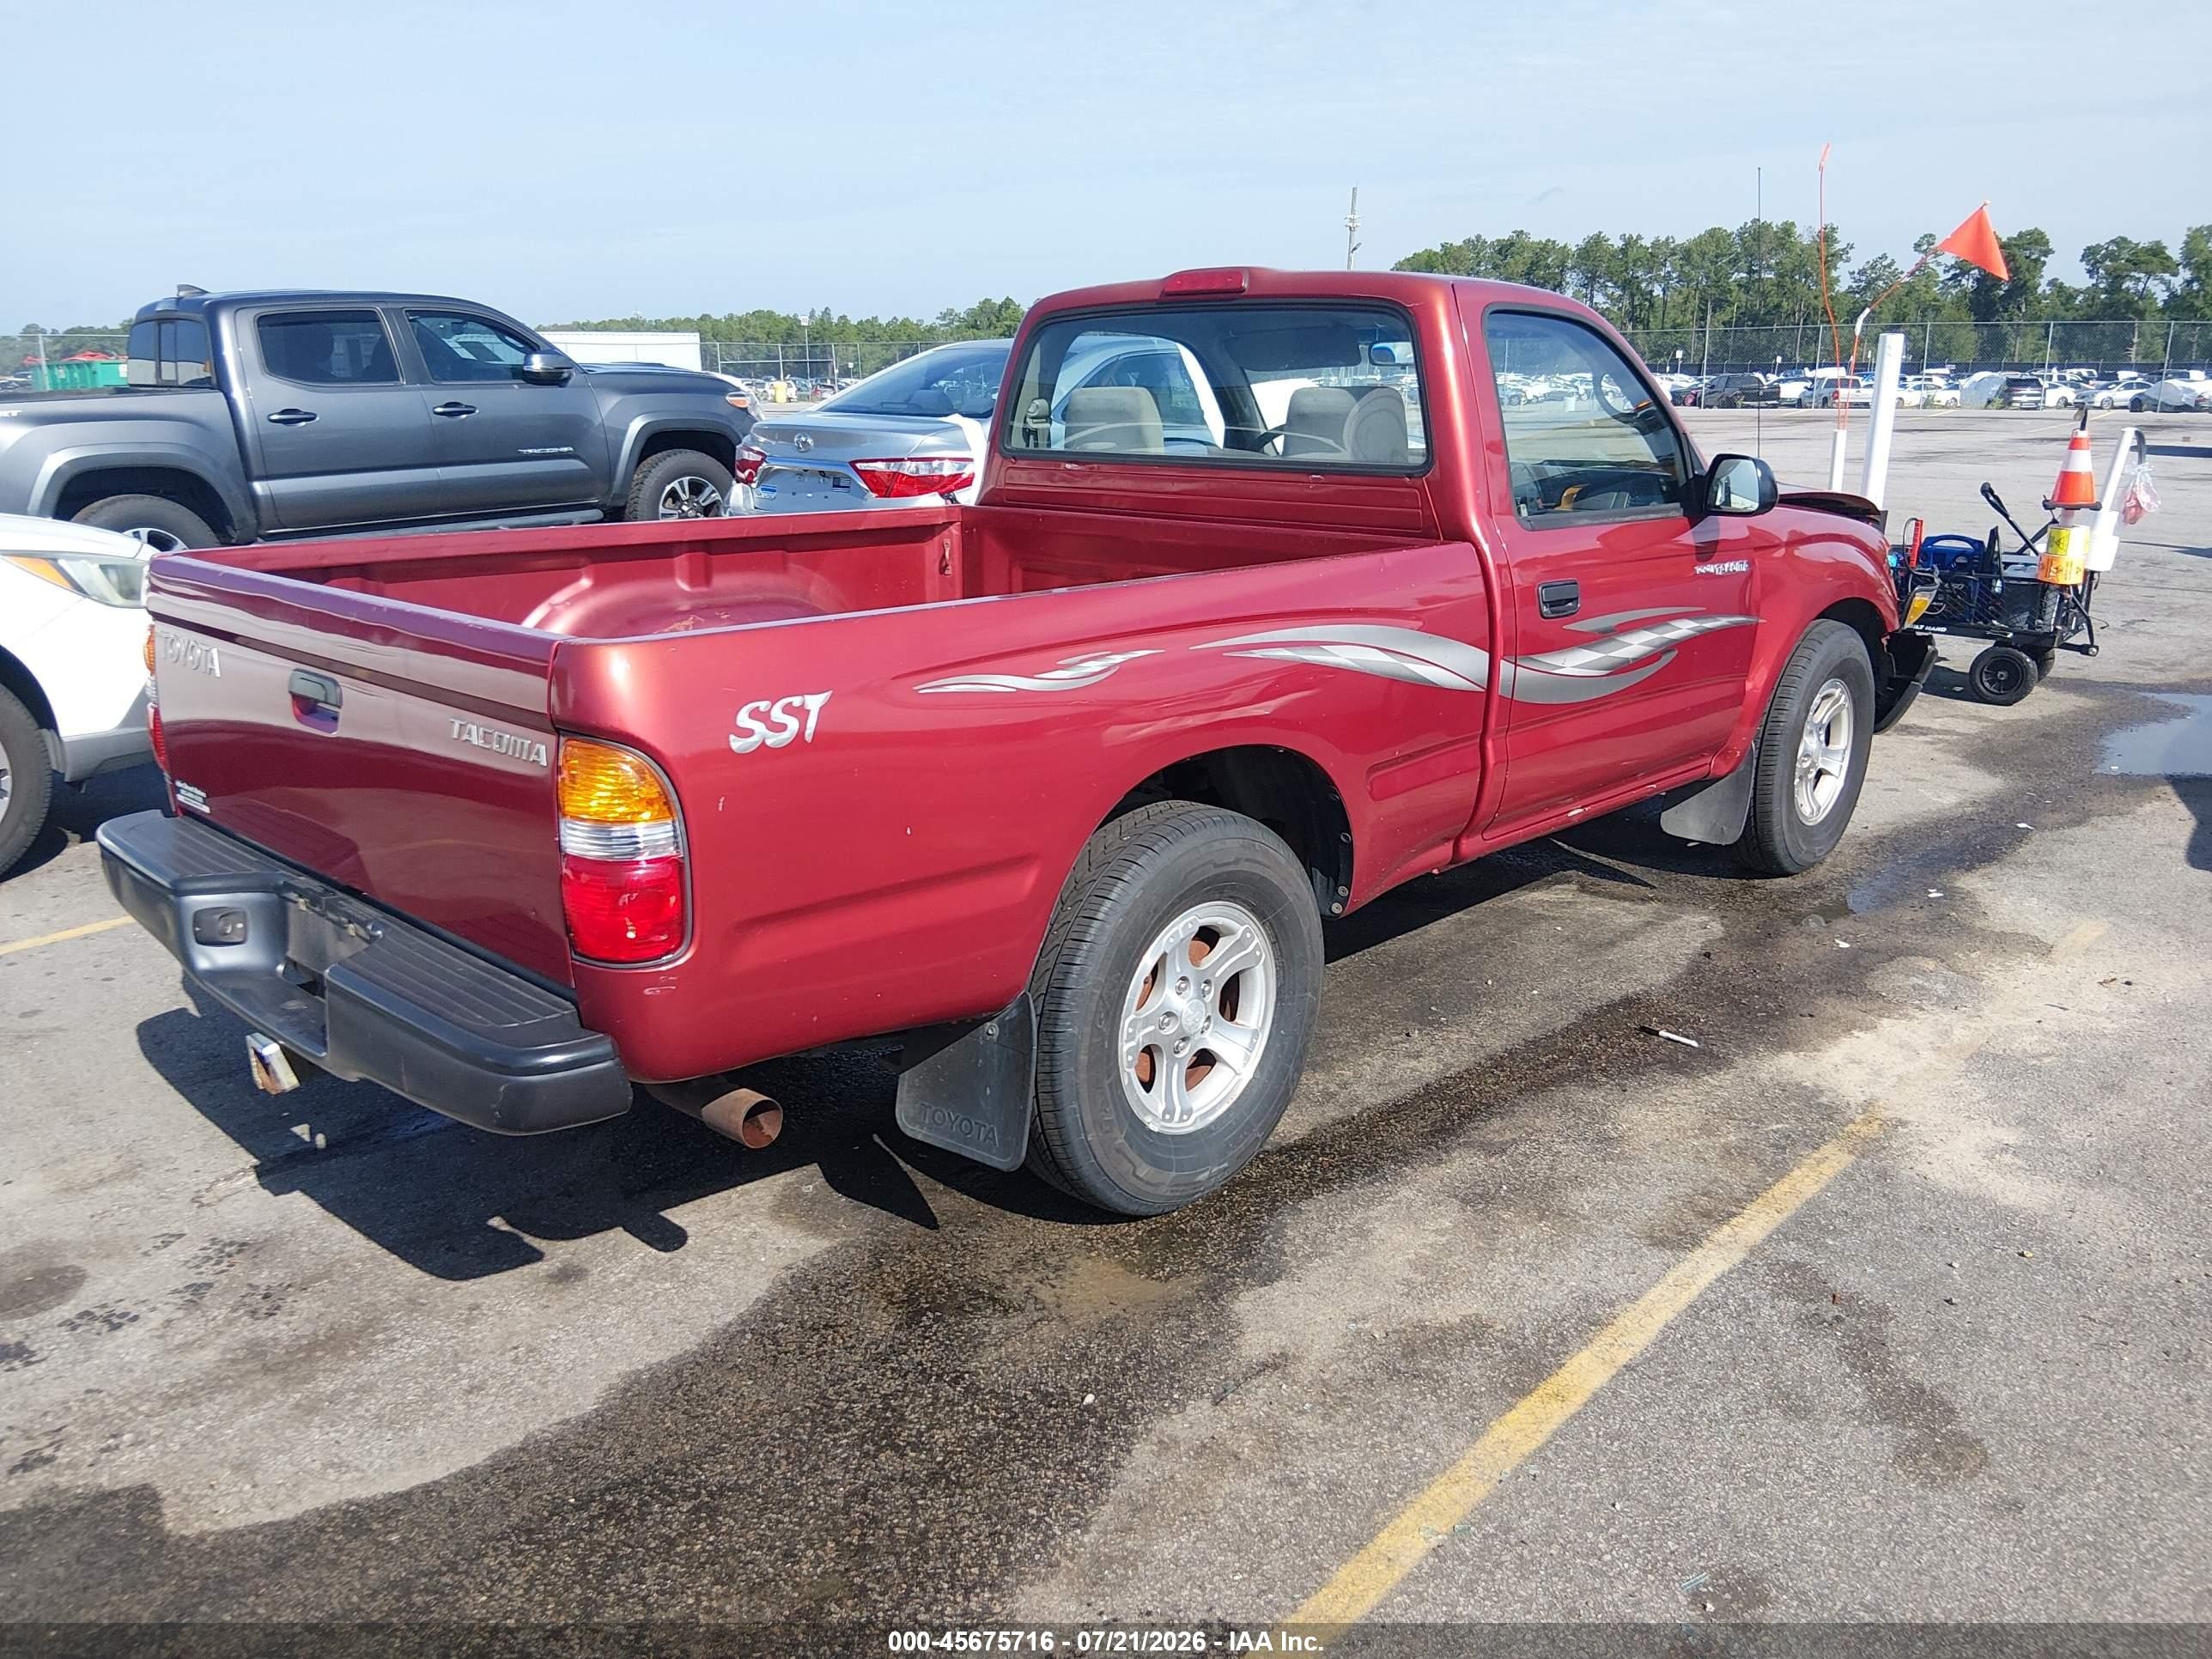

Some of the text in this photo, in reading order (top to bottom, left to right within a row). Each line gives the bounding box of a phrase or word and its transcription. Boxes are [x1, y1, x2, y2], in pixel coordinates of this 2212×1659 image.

[161, 631, 221, 678] TOYOTA
[449, 718, 548, 767] TACOMA
[728, 690, 833, 754] SST
[920, 1101, 1000, 1148] TOYOTA
